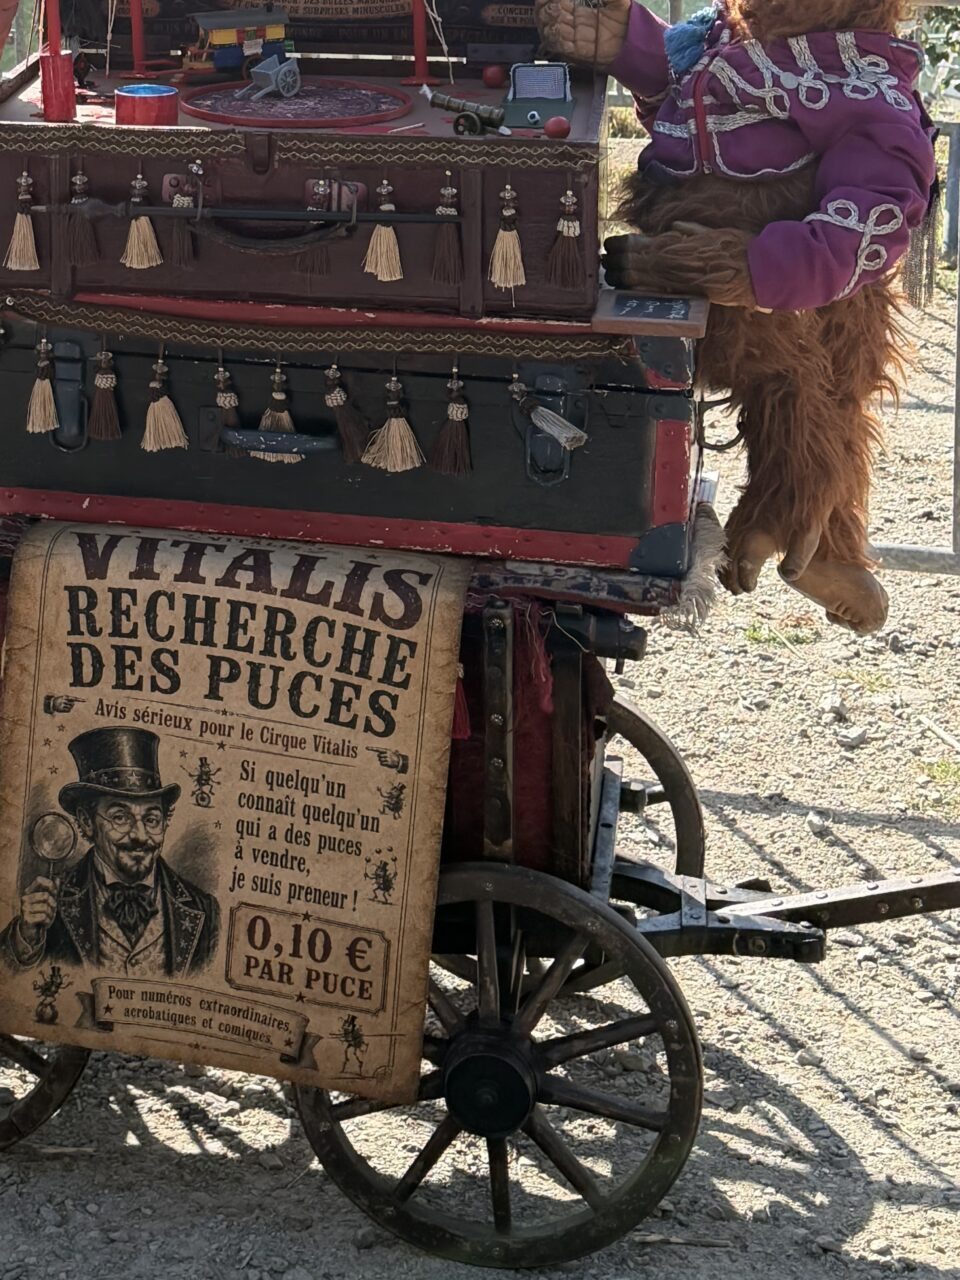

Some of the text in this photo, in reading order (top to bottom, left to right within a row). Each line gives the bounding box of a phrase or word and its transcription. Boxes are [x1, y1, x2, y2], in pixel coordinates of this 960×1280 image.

[288, 5, 298, 15] DE
[302, 6, 349, 16] SURPRISES
[352, 3, 406, 15] MINUSCULES
[70, 532, 433, 630] VITALIS
[63, 585, 419, 690] RECHERCHE
[67, 641, 400, 739] DES PUCES
[94, 698, 359, 759] Avis sérieux pour le Cirque Vitalis
[240, 759, 346, 799] Si quelqu'un
[238, 791, 381, 833] connaît quelqu'un
[234, 839, 311, 877] à vendre,
[236, 817, 363, 857] qui a des puces
[229, 866, 245, 892] je
[251, 873, 282, 897] suis
[287, 882, 348, 910] preneur
[246, 914, 373, 973] 0,10 €
[243, 954, 373, 1001] PAR PUCE
[108, 985, 293, 1034] Pour numéros extraordinaires,
[124, 1005, 274, 1045] acrobatiques et comiques.
